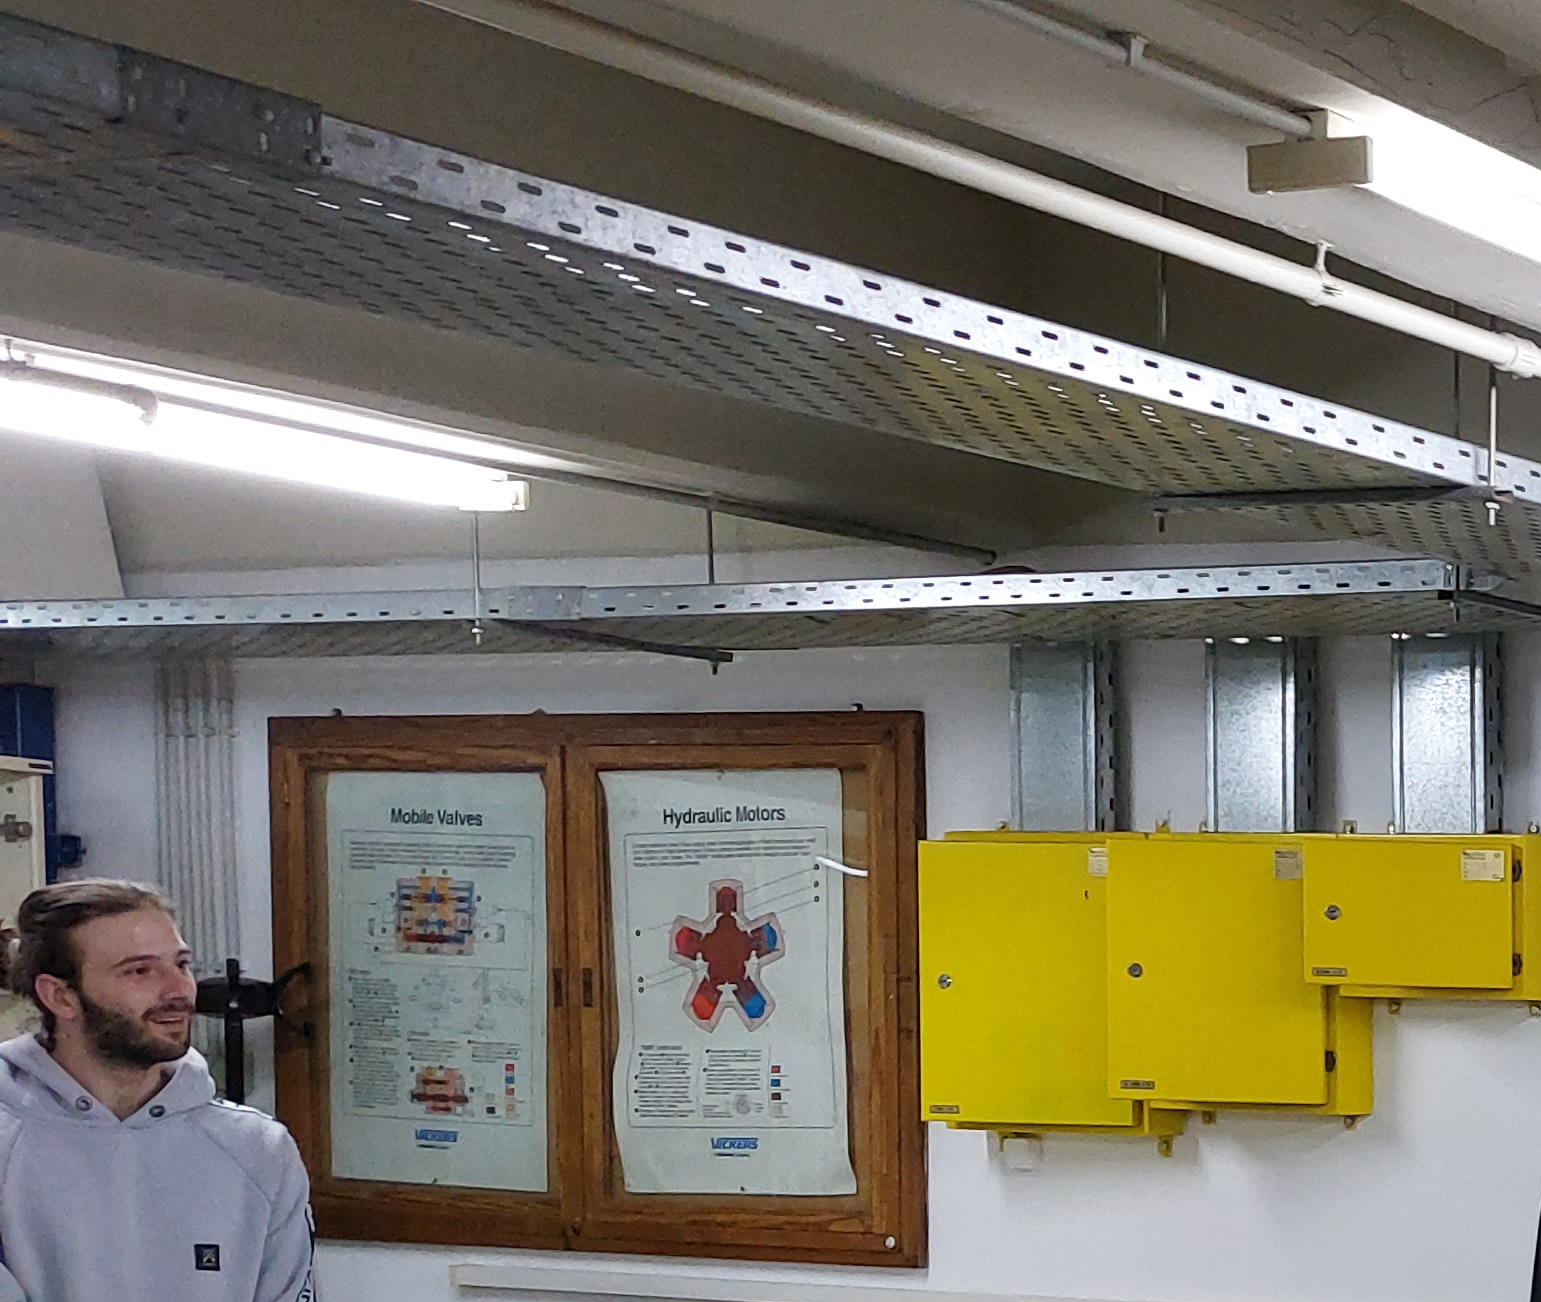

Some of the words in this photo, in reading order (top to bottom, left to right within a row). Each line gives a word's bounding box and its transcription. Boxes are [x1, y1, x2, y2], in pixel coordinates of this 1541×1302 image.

[391, 808, 434, 825] Mobile
[437, 809, 483, 826] Valves
[663, 807, 732, 828] Hydraulic
[736, 806, 785, 822] Motors
